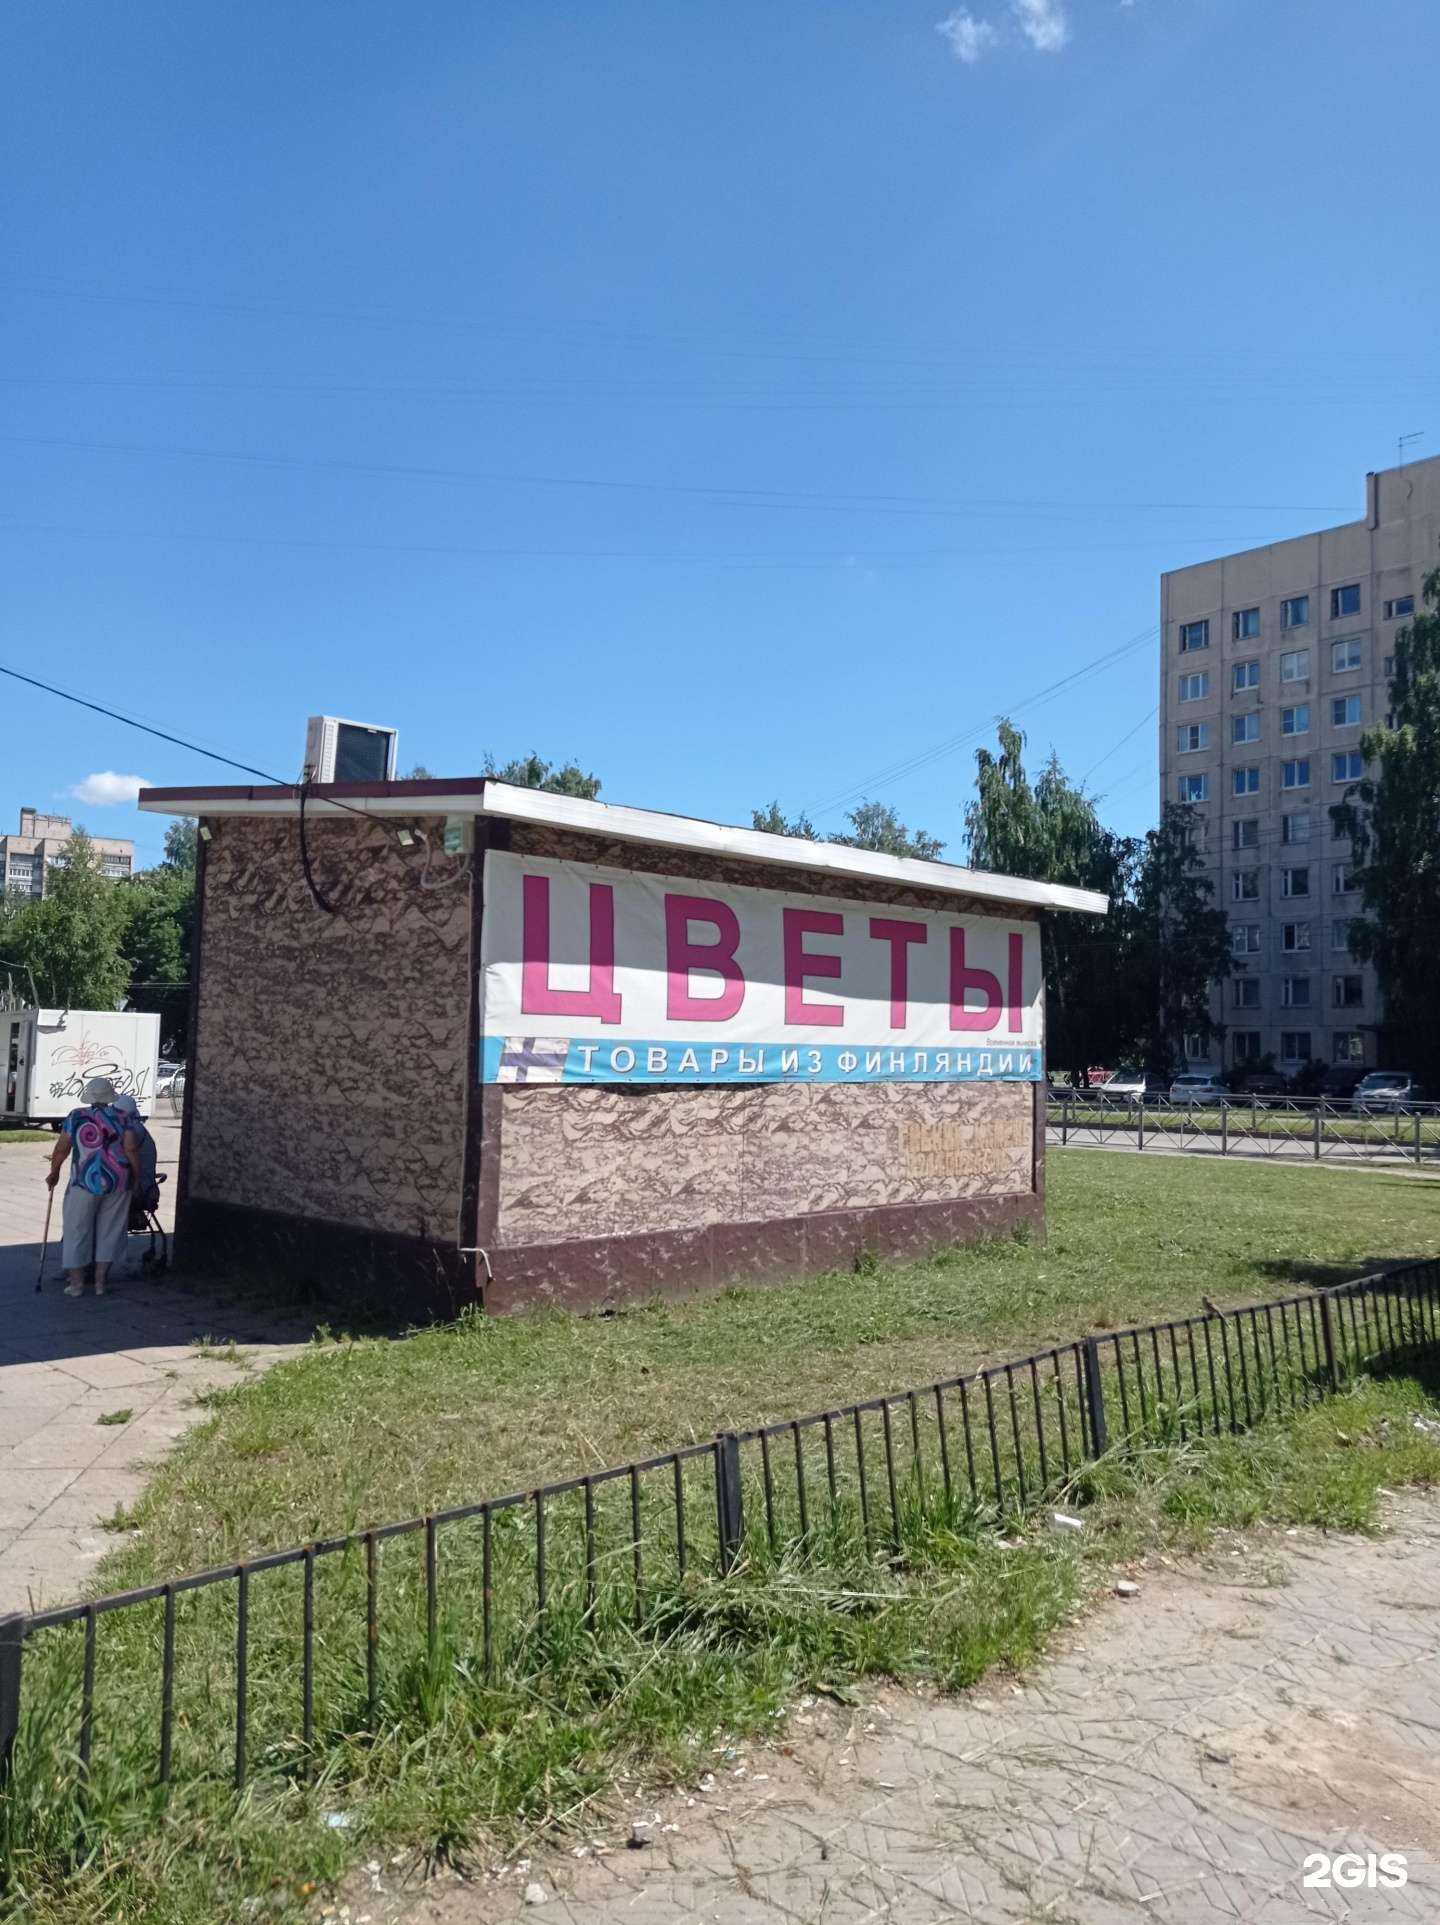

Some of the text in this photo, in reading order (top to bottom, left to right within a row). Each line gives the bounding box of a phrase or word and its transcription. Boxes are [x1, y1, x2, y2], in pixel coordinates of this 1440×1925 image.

[521, 875, 1023, 1033] ЦВЕТЫ
[578, 1046, 1032, 1076] ТОВАРЫ ИЗ ФИНЛЯНДИИ
